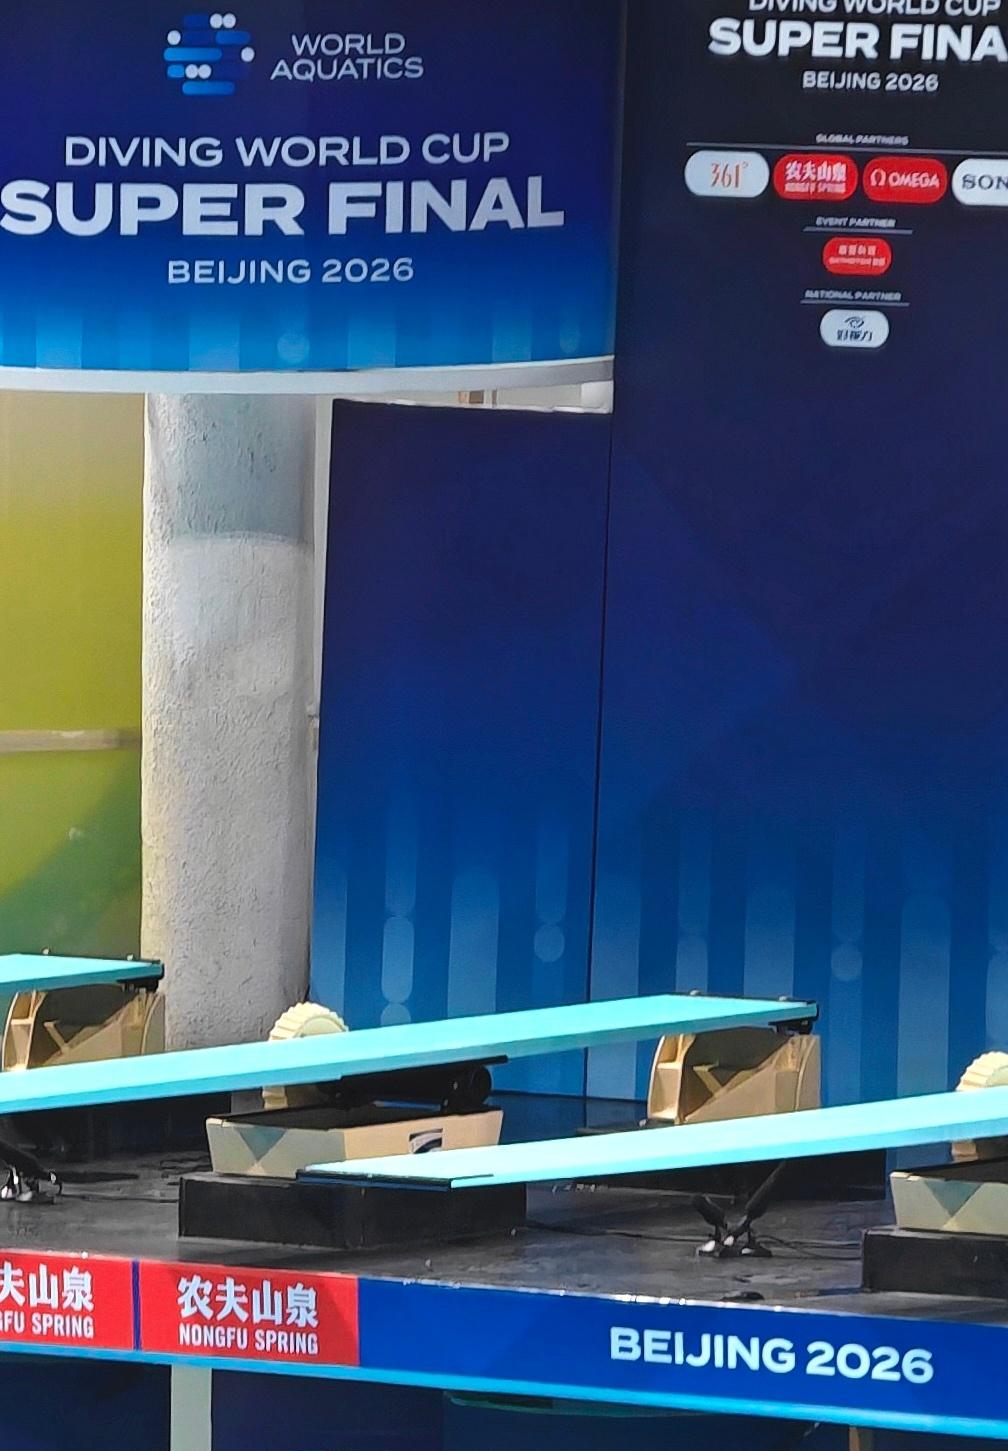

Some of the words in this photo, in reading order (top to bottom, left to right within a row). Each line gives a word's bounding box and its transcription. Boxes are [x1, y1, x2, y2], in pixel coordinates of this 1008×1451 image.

[291, 33, 405, 56] WORLD
[708, 17, 879, 58] SUPER
[890, 23, 1008, 62] FINA
[270, 57, 424, 82] AQUATICS
[803, 70, 881, 90] BEIJING
[885, 72, 939, 92] 2026
[64, 135, 222, 167] DIVING
[235, 135, 410, 166] WORLD
[421, 132, 510, 164] CUP
[888, 172, 940, 188] OMEGA
[327, 176, 566, 236] FINAL
[168, 260, 311, 284] BEIJING
[322, 258, 414, 282] 2026
[177, 1274, 319, 1329] 农夫山泉
[31, 1313, 94, 1339] SPRING
[178, 1323, 248, 1349] NONGFU
[255, 1330, 319, 1356] SPRING
[610, 1326, 795, 1374] BEIJING
[806, 1340, 934, 1384] 2026
